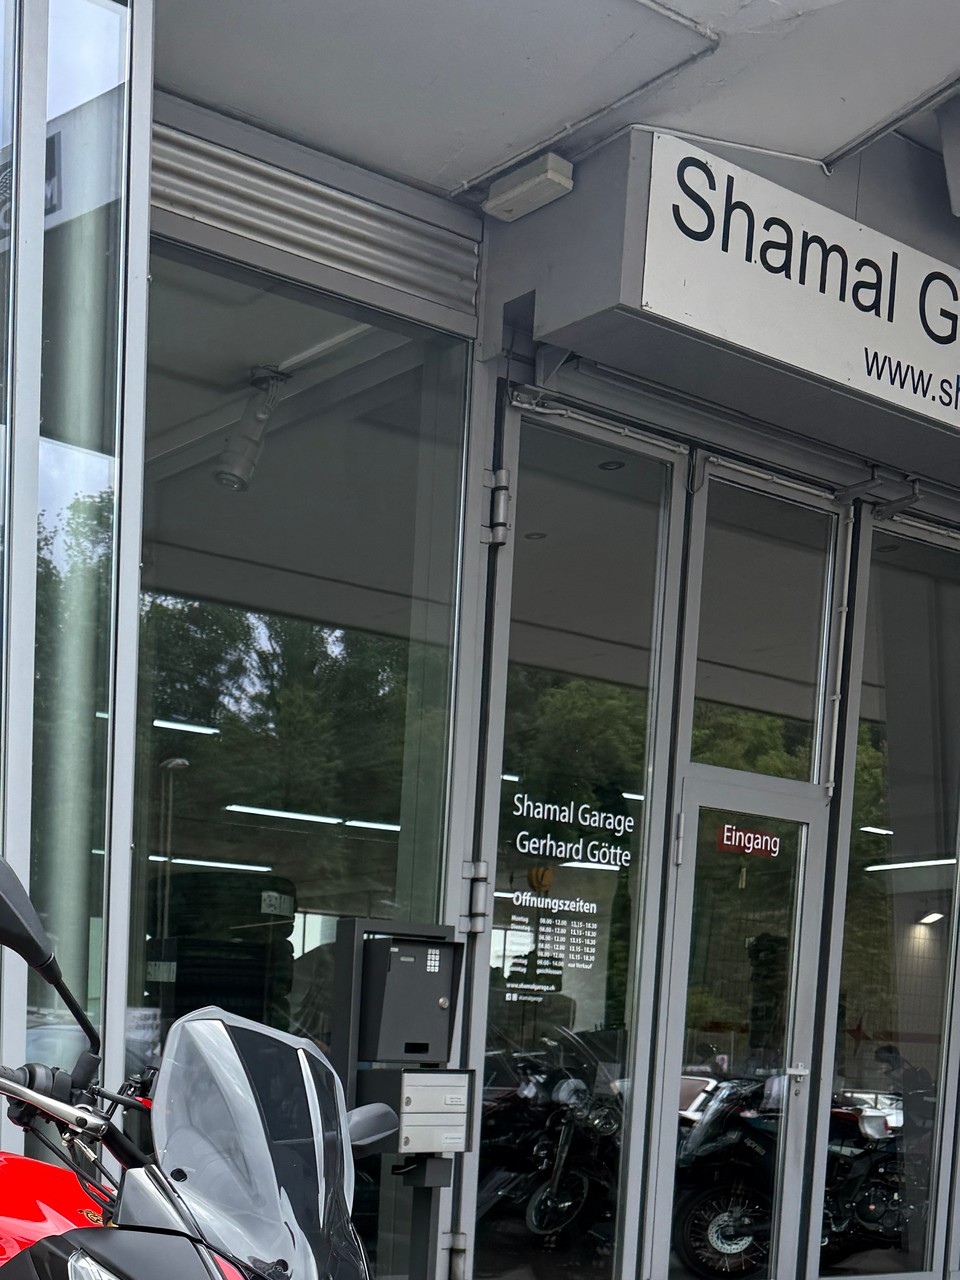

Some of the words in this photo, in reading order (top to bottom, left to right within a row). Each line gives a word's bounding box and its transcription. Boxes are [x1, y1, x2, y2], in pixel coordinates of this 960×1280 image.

[672, 156, 898, 323] Shamal
[512, 794, 574, 823] Shamal
[578, 804, 635, 836] Garage
[516, 831, 583, 860] Gerhard
[587, 841, 631, 867] Götte
[723, 824, 780, 857] Eingang
